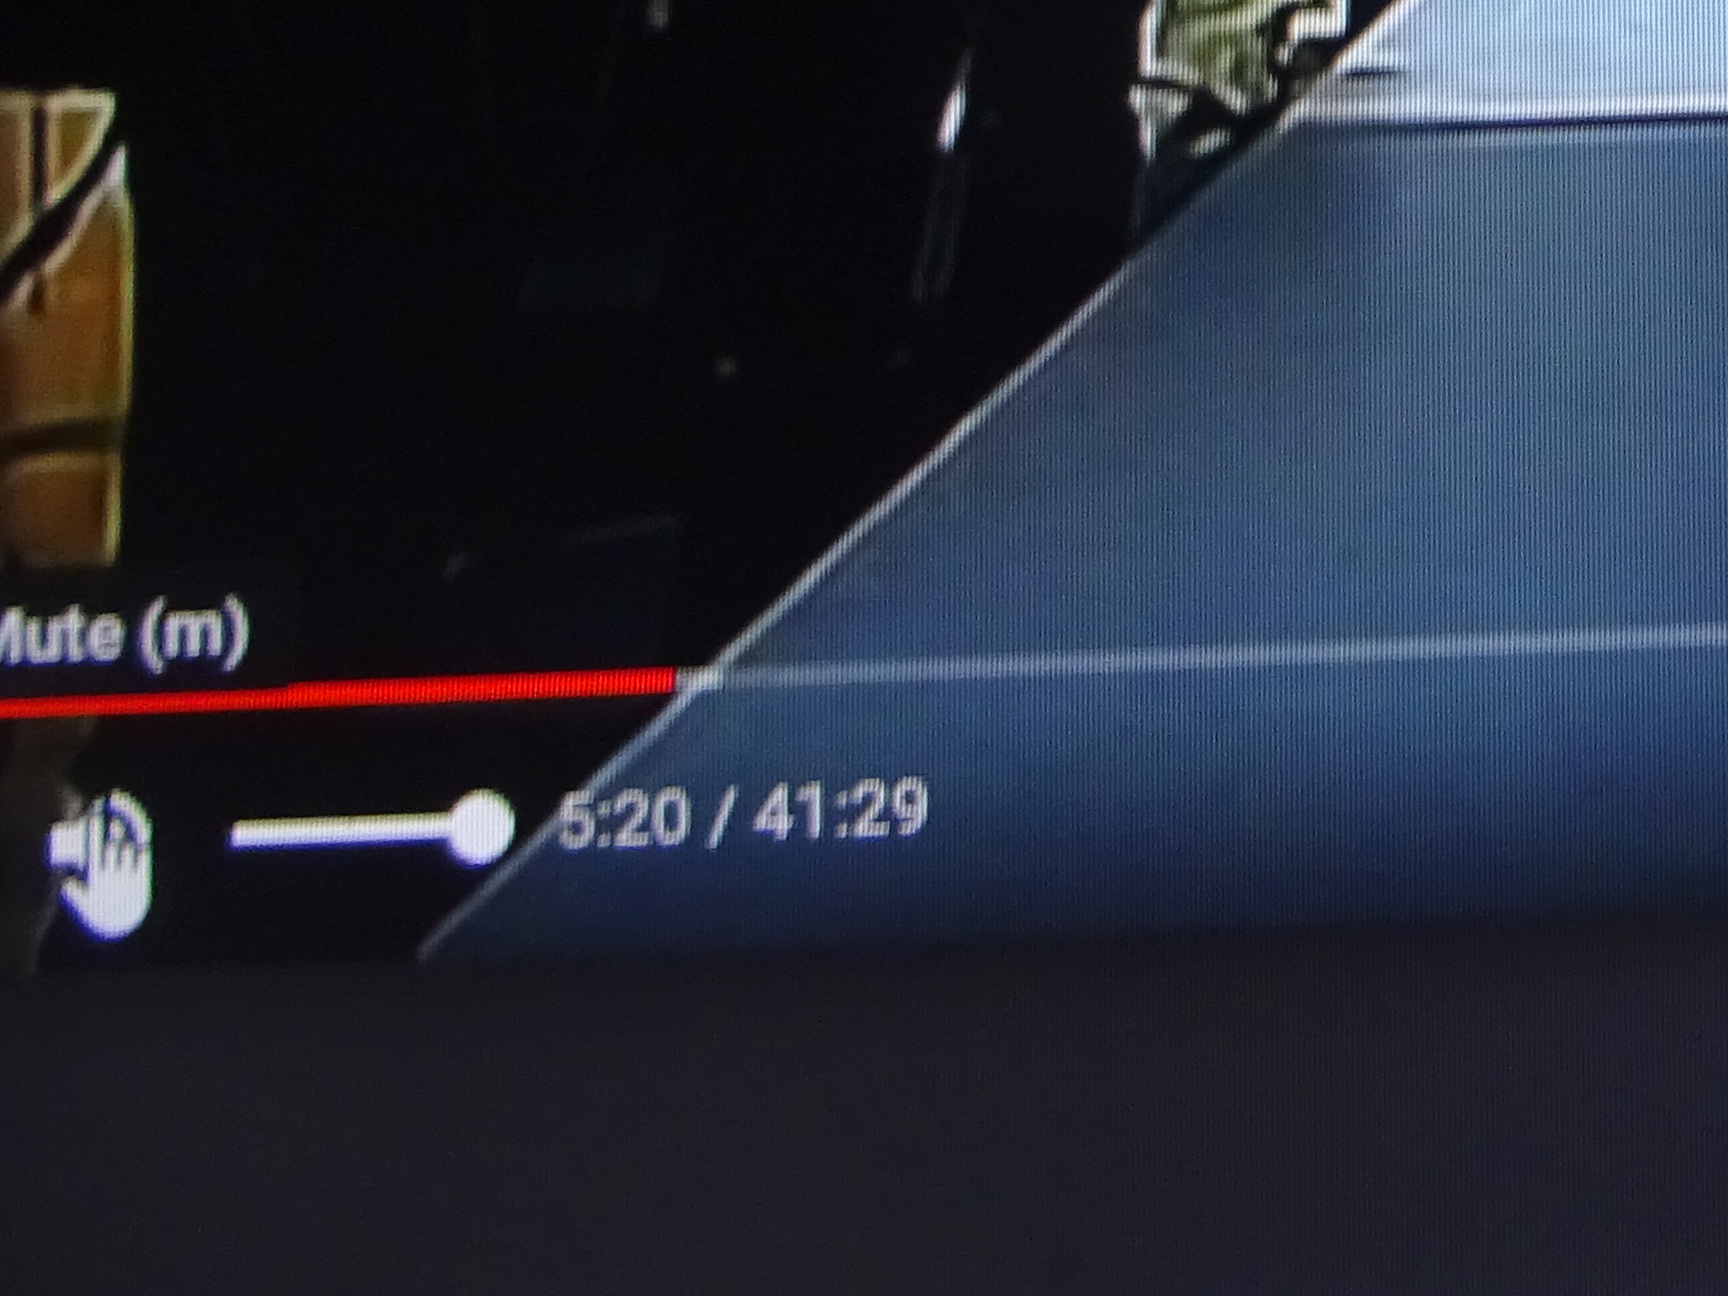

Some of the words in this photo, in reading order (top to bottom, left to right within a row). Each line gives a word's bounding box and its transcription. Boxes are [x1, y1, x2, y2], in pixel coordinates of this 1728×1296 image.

[140, 592, 249, 675] (m)
[559, 786, 692, 850] 5:20
[704, 784, 738, 850] /
[752, 775, 929, 842] 41:29
